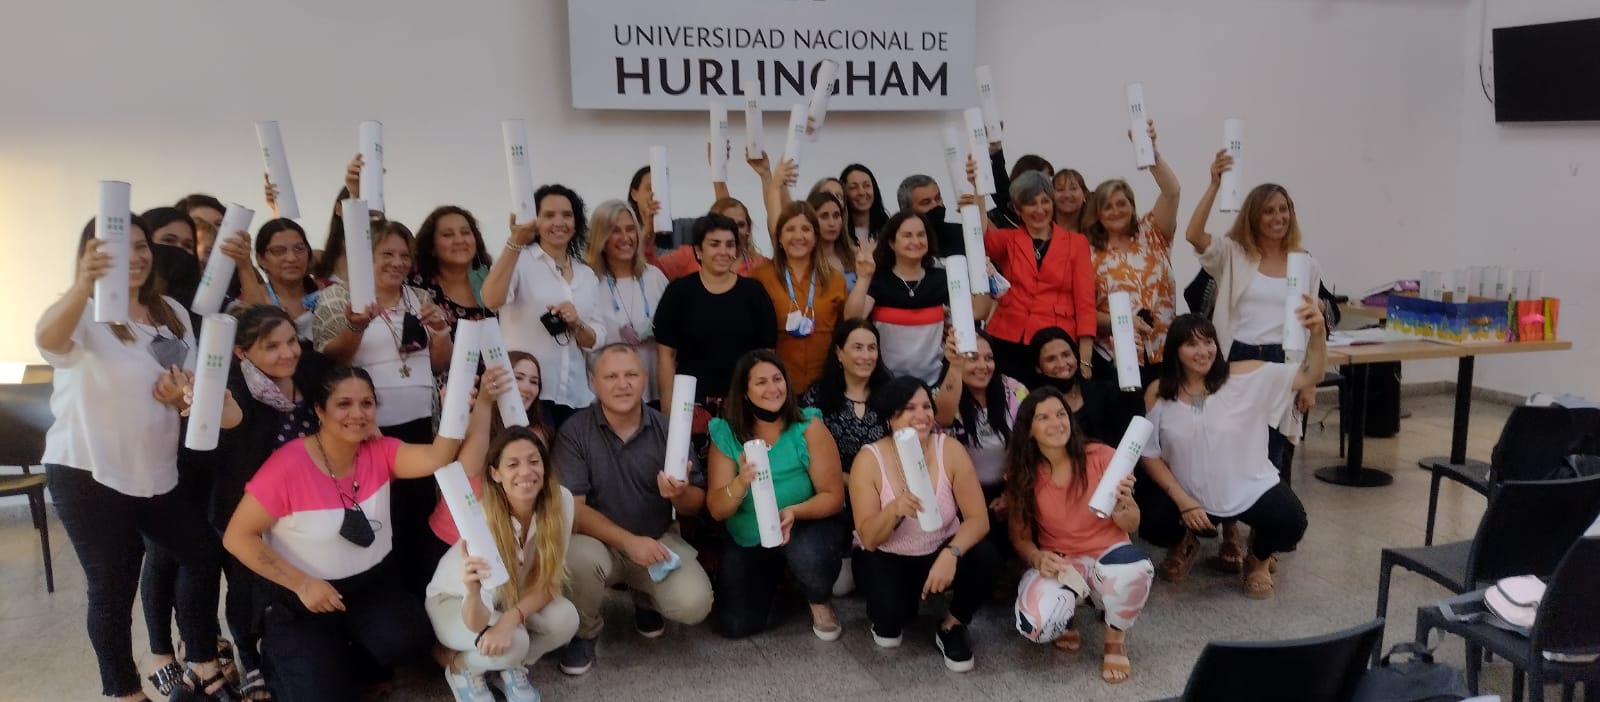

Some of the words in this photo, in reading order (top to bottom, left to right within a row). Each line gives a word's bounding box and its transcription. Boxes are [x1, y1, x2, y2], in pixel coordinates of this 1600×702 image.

[614, 24, 785, 49] UNIVERSIDAD
[793, 29, 914, 51] NACIONAL
[921, 31, 949, 52] DE
